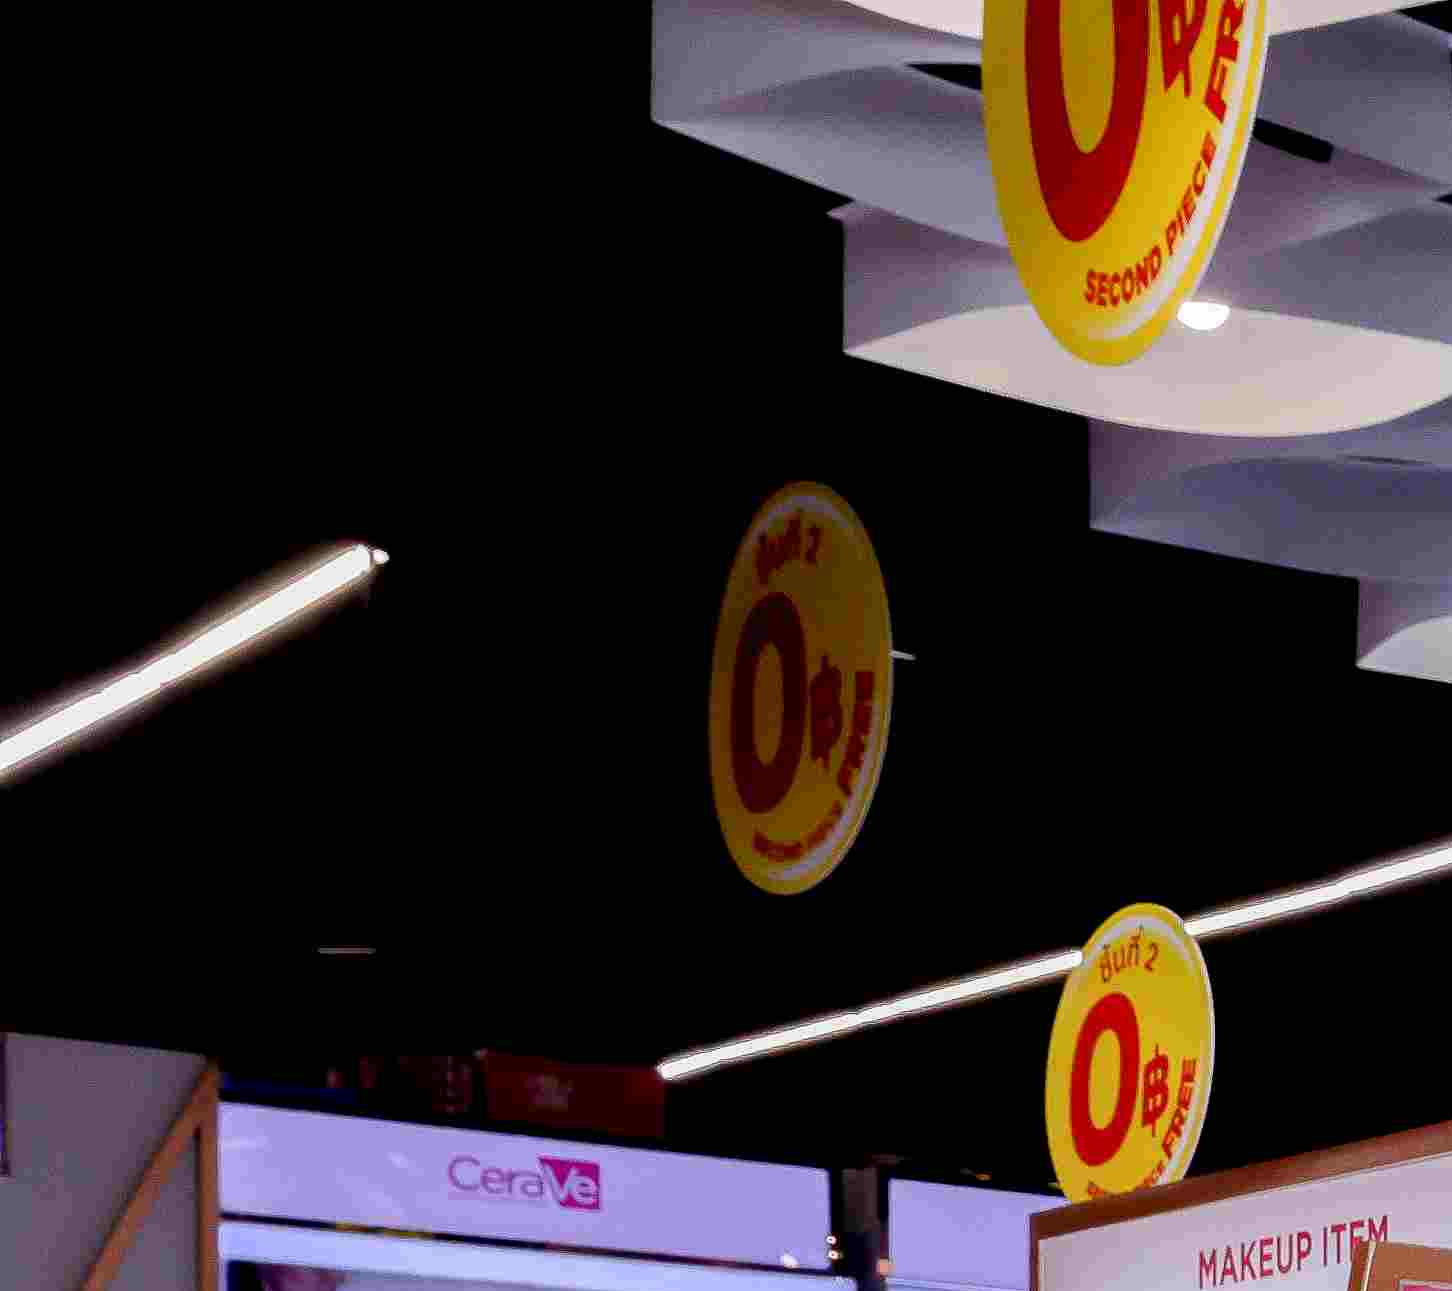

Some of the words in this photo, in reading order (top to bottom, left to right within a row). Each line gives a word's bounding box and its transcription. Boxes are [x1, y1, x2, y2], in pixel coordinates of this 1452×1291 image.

[1084, 255, 1163, 308] SECOND
[1163, 177, 1211, 260] PIECE
[1145, 941, 1160, 972] 2
[1162, 1058, 1198, 1162] FREE
[447, 1155, 602, 1211] CeraVe
[1198, 1227, 1312, 1289] MAKEUP
